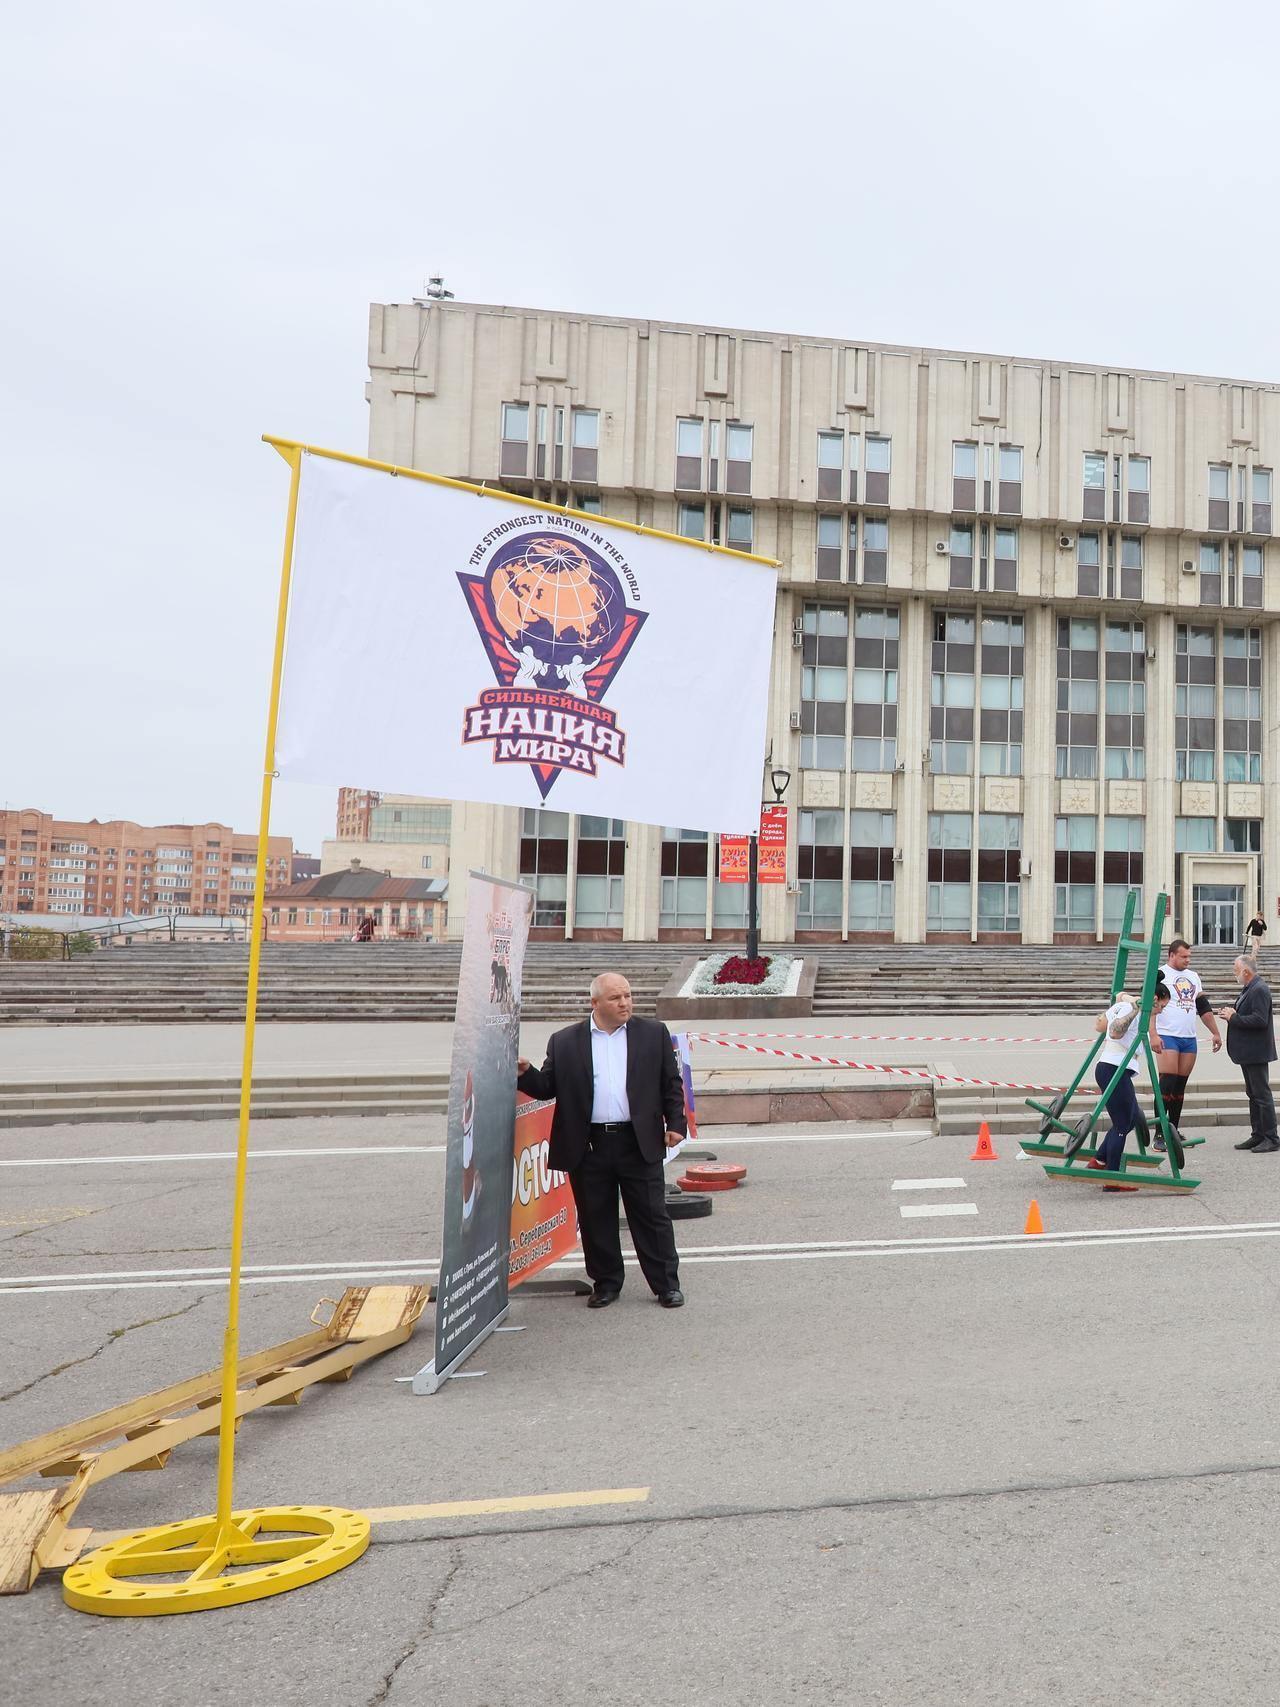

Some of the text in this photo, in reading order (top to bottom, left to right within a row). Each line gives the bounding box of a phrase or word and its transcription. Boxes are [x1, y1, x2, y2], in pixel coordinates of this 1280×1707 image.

[469, 543, 488, 567] THE
[483, 514, 544, 548] STRONGEST
[547, 515, 589, 537] NATION
[590, 531, 604, 545] IN
[605, 541, 625, 564] THE
[620, 562, 641, 601] WORLD
[483, 691, 613, 724] СИЛЬНЕЙШАЯ
[468, 706, 622, 760] НАЦИЯ
[499, 738, 593, 772] МИРА
[721, 847, 747, 857] ТУЛА
[760, 848, 785, 858] ТУЛА
